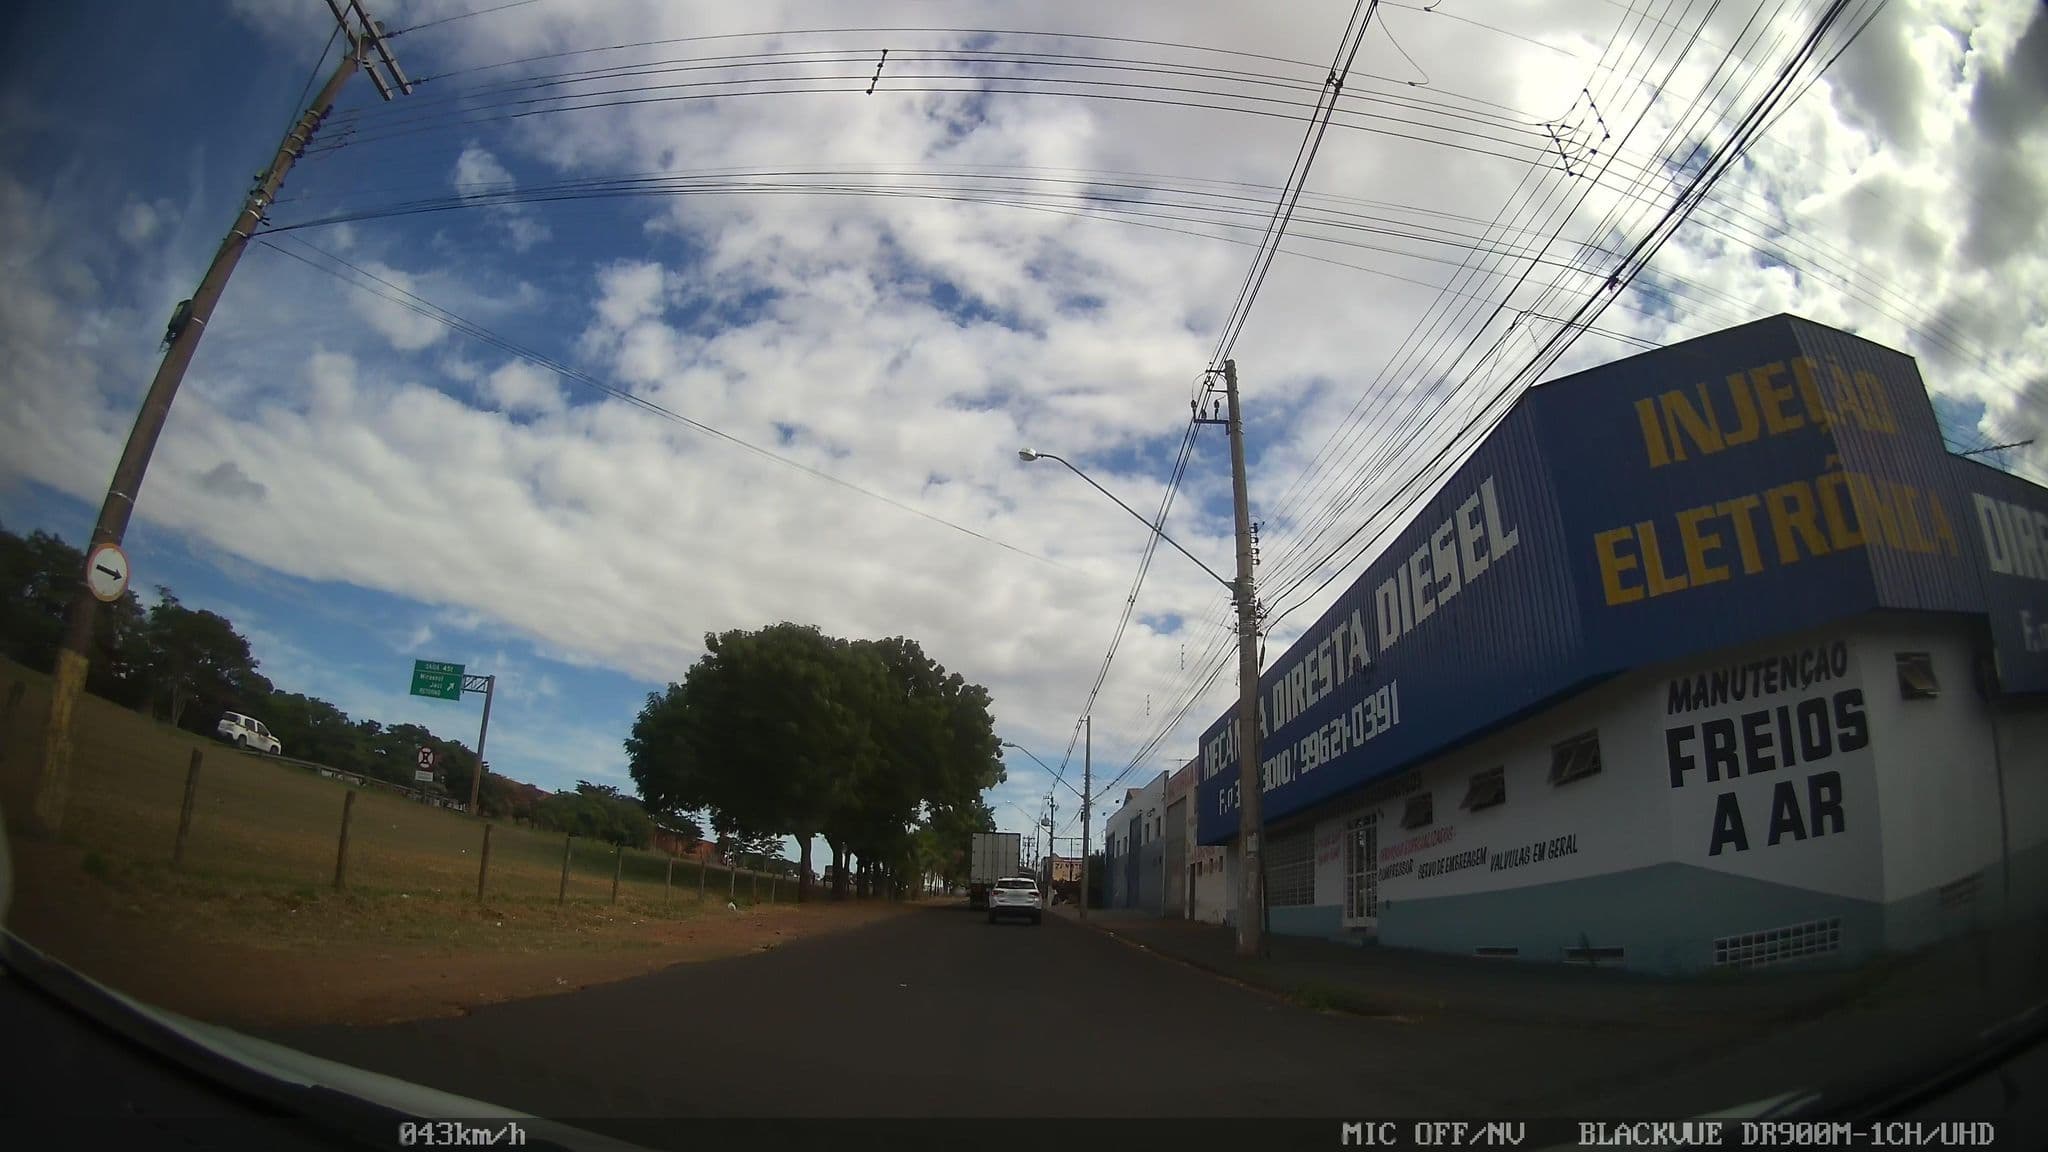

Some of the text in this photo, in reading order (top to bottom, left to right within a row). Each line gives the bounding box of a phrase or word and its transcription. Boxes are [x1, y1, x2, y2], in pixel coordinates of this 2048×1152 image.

[1634, 352, 1898, 469] INJEÇÃO
[1594, 453, 1959, 606] ELETRÔNICA
[1272, 608, 1372, 732] DIRESTA
[1375, 474, 1519, 653] DIESEL
[1301, 679, 1400, 774] 99621-0391
[1666, 688, 1869, 789] FREIOS
[1532, 841, 1546, 862] EM
[1548, 833, 1578, 859] GERAL
[1708, 771, 1846, 857] A AR
